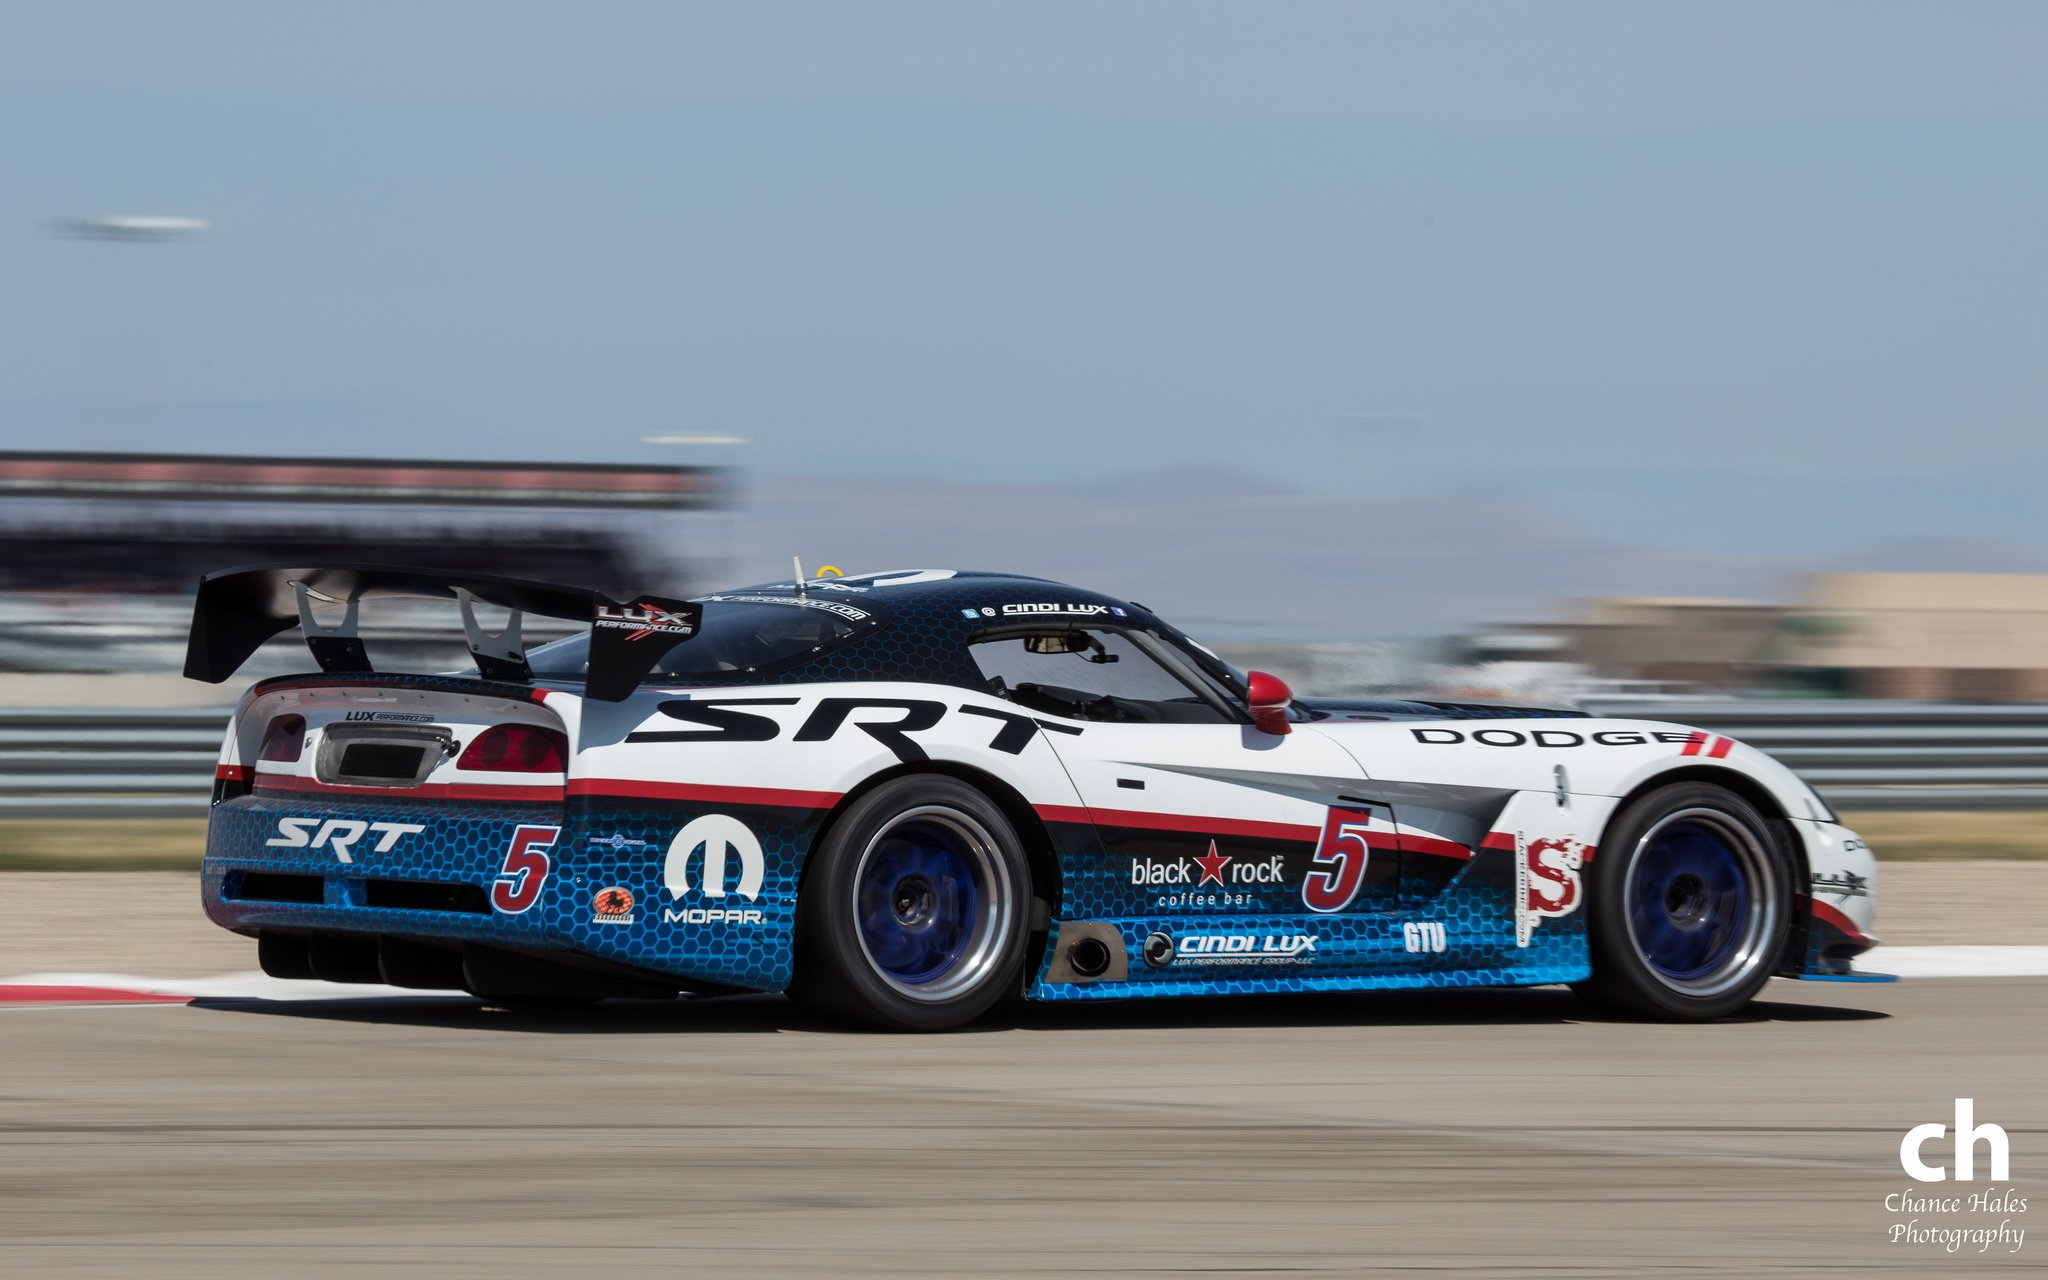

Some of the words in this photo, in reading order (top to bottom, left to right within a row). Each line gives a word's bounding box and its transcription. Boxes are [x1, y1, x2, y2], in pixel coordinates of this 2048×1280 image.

[596, 605, 693, 626] LUX
[1002, 603, 1060, 615] CINDI
[1067, 603, 1109, 615] LUX
[596, 620, 692, 634] PERFORMANCE.COM
[345, 711, 375, 721] LUX
[623, 697, 1085, 763] SRT
[1409, 728, 1705, 748] DODGE
[265, 817, 426, 863] SRT
[1301, 804, 1371, 913] 5
[491, 824, 562, 915] 5
[1131, 857, 1191, 884] black
[1232, 856, 1284, 883] rock
[1158, 893, 1216, 907] coffee
[1224, 892, 1253, 905] bar
[663, 908, 762, 924] MOPAR
[1179, 935, 1256, 952] CINDI
[1262, 935, 1319, 953] LUX
[1403, 922, 1447, 953] GTU
[1172, 958, 1191, 966] LUX
[1192, 957, 1262, 966] PERFORMANCE
